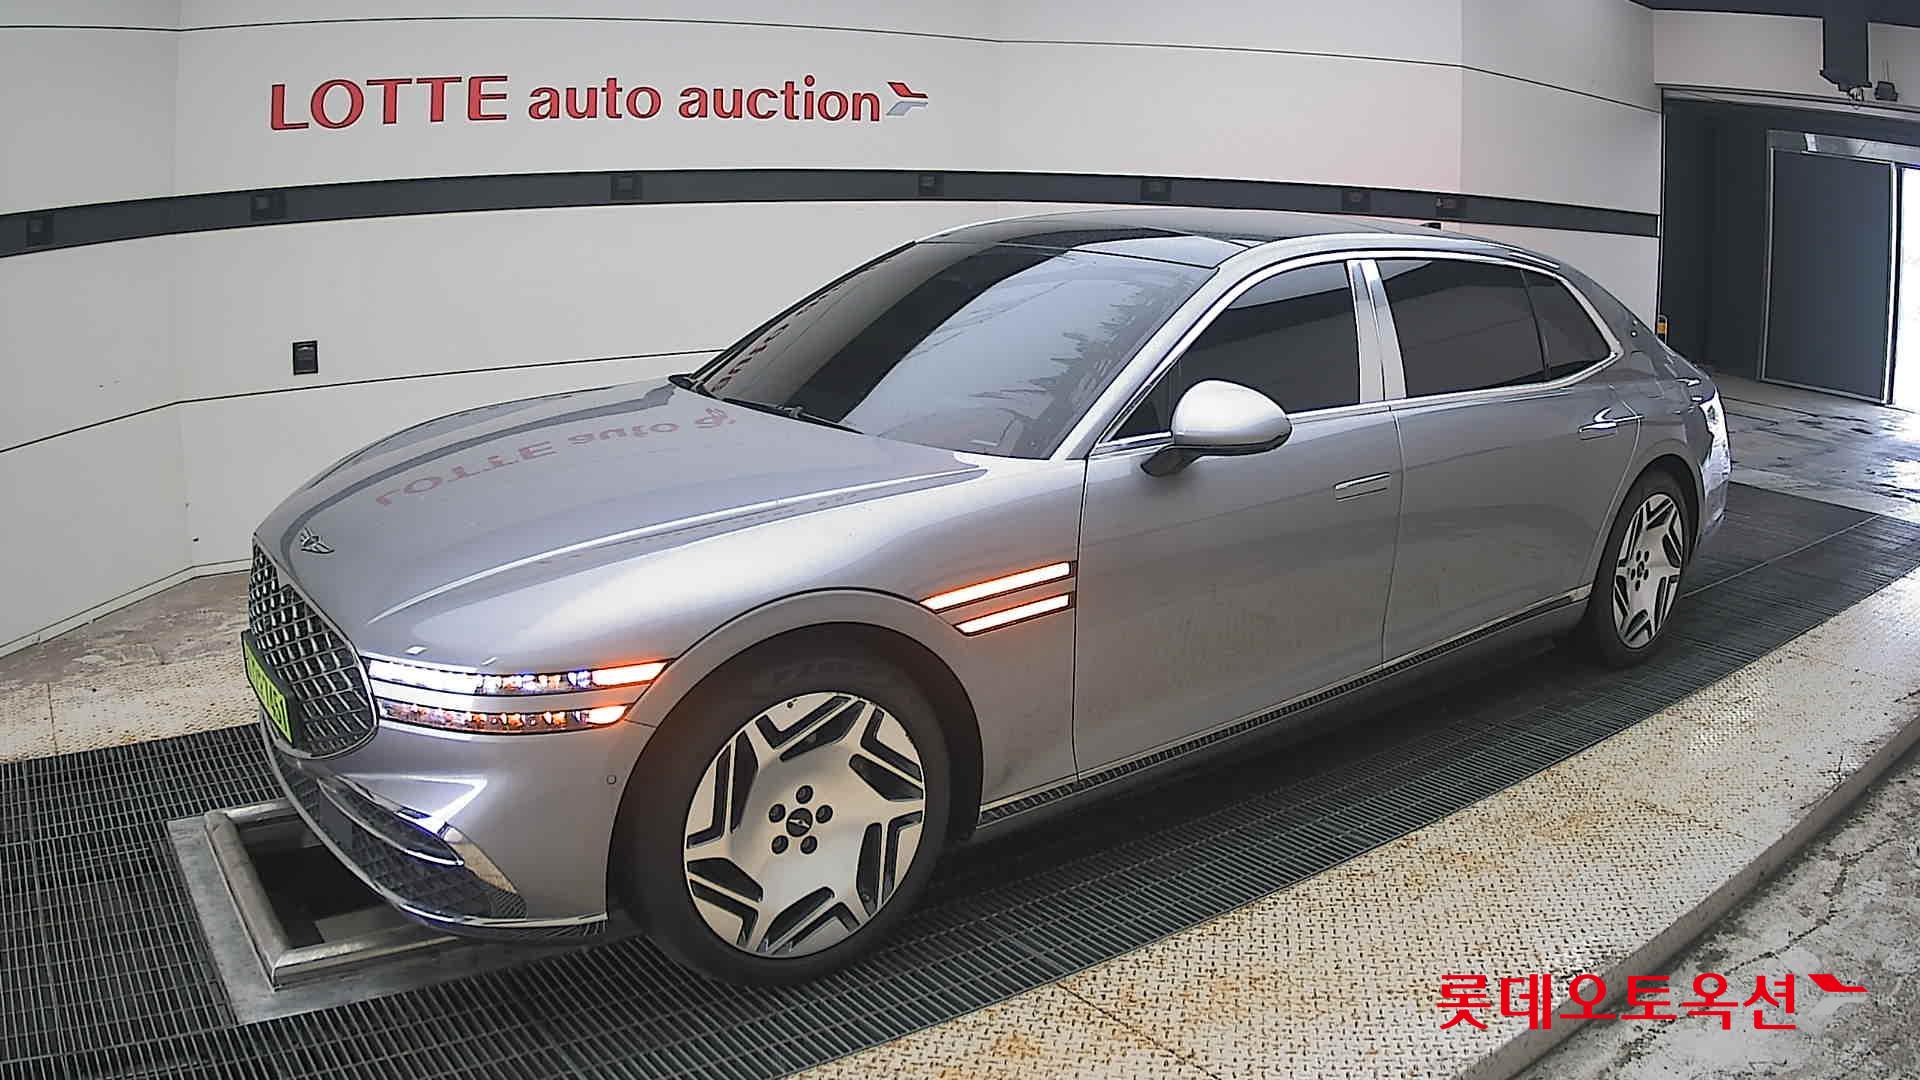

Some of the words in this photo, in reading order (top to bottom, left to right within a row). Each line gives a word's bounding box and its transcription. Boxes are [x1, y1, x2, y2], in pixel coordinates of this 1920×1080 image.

[270, 75, 508, 131] LOTTE
[528, 77, 663, 120] auto
[678, 74, 881, 122] auction
